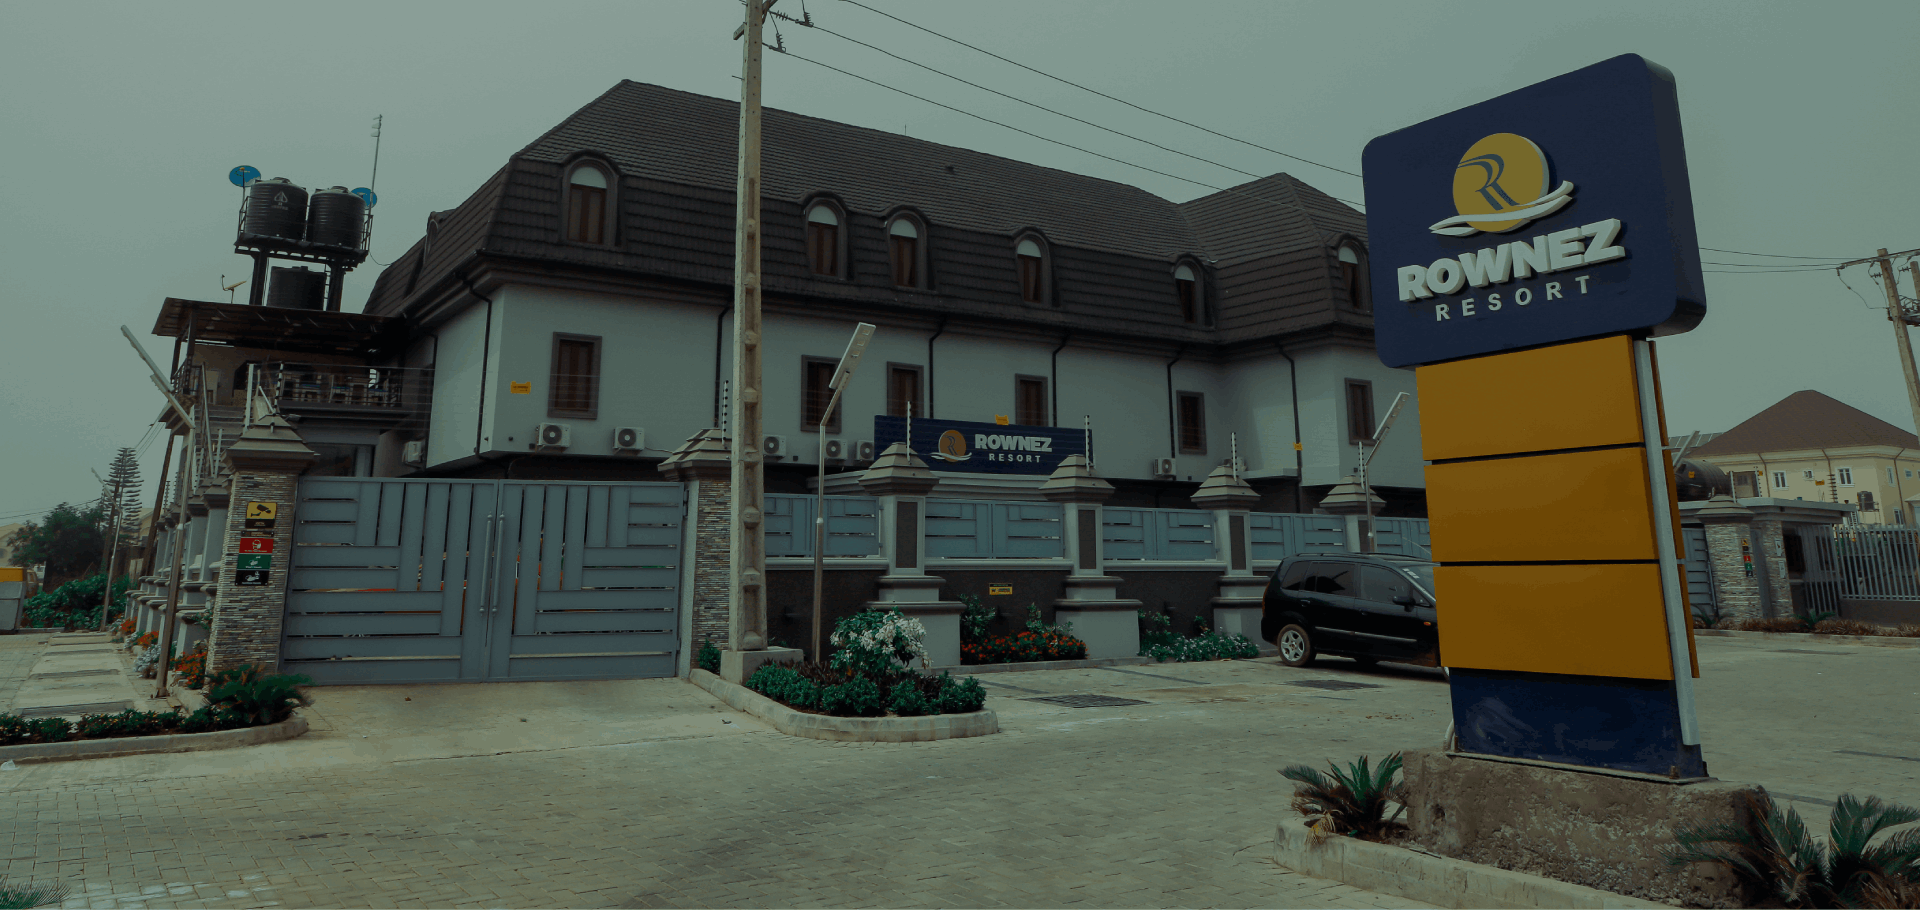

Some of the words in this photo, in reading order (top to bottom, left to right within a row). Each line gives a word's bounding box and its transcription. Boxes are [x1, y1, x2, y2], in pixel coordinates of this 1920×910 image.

[1397, 218, 1626, 302] ROWNEZ
[1435, 275, 1590, 321] RESORT
[974, 434, 1053, 452] ROWNEZ
[989, 453, 1041, 463] RESORT
